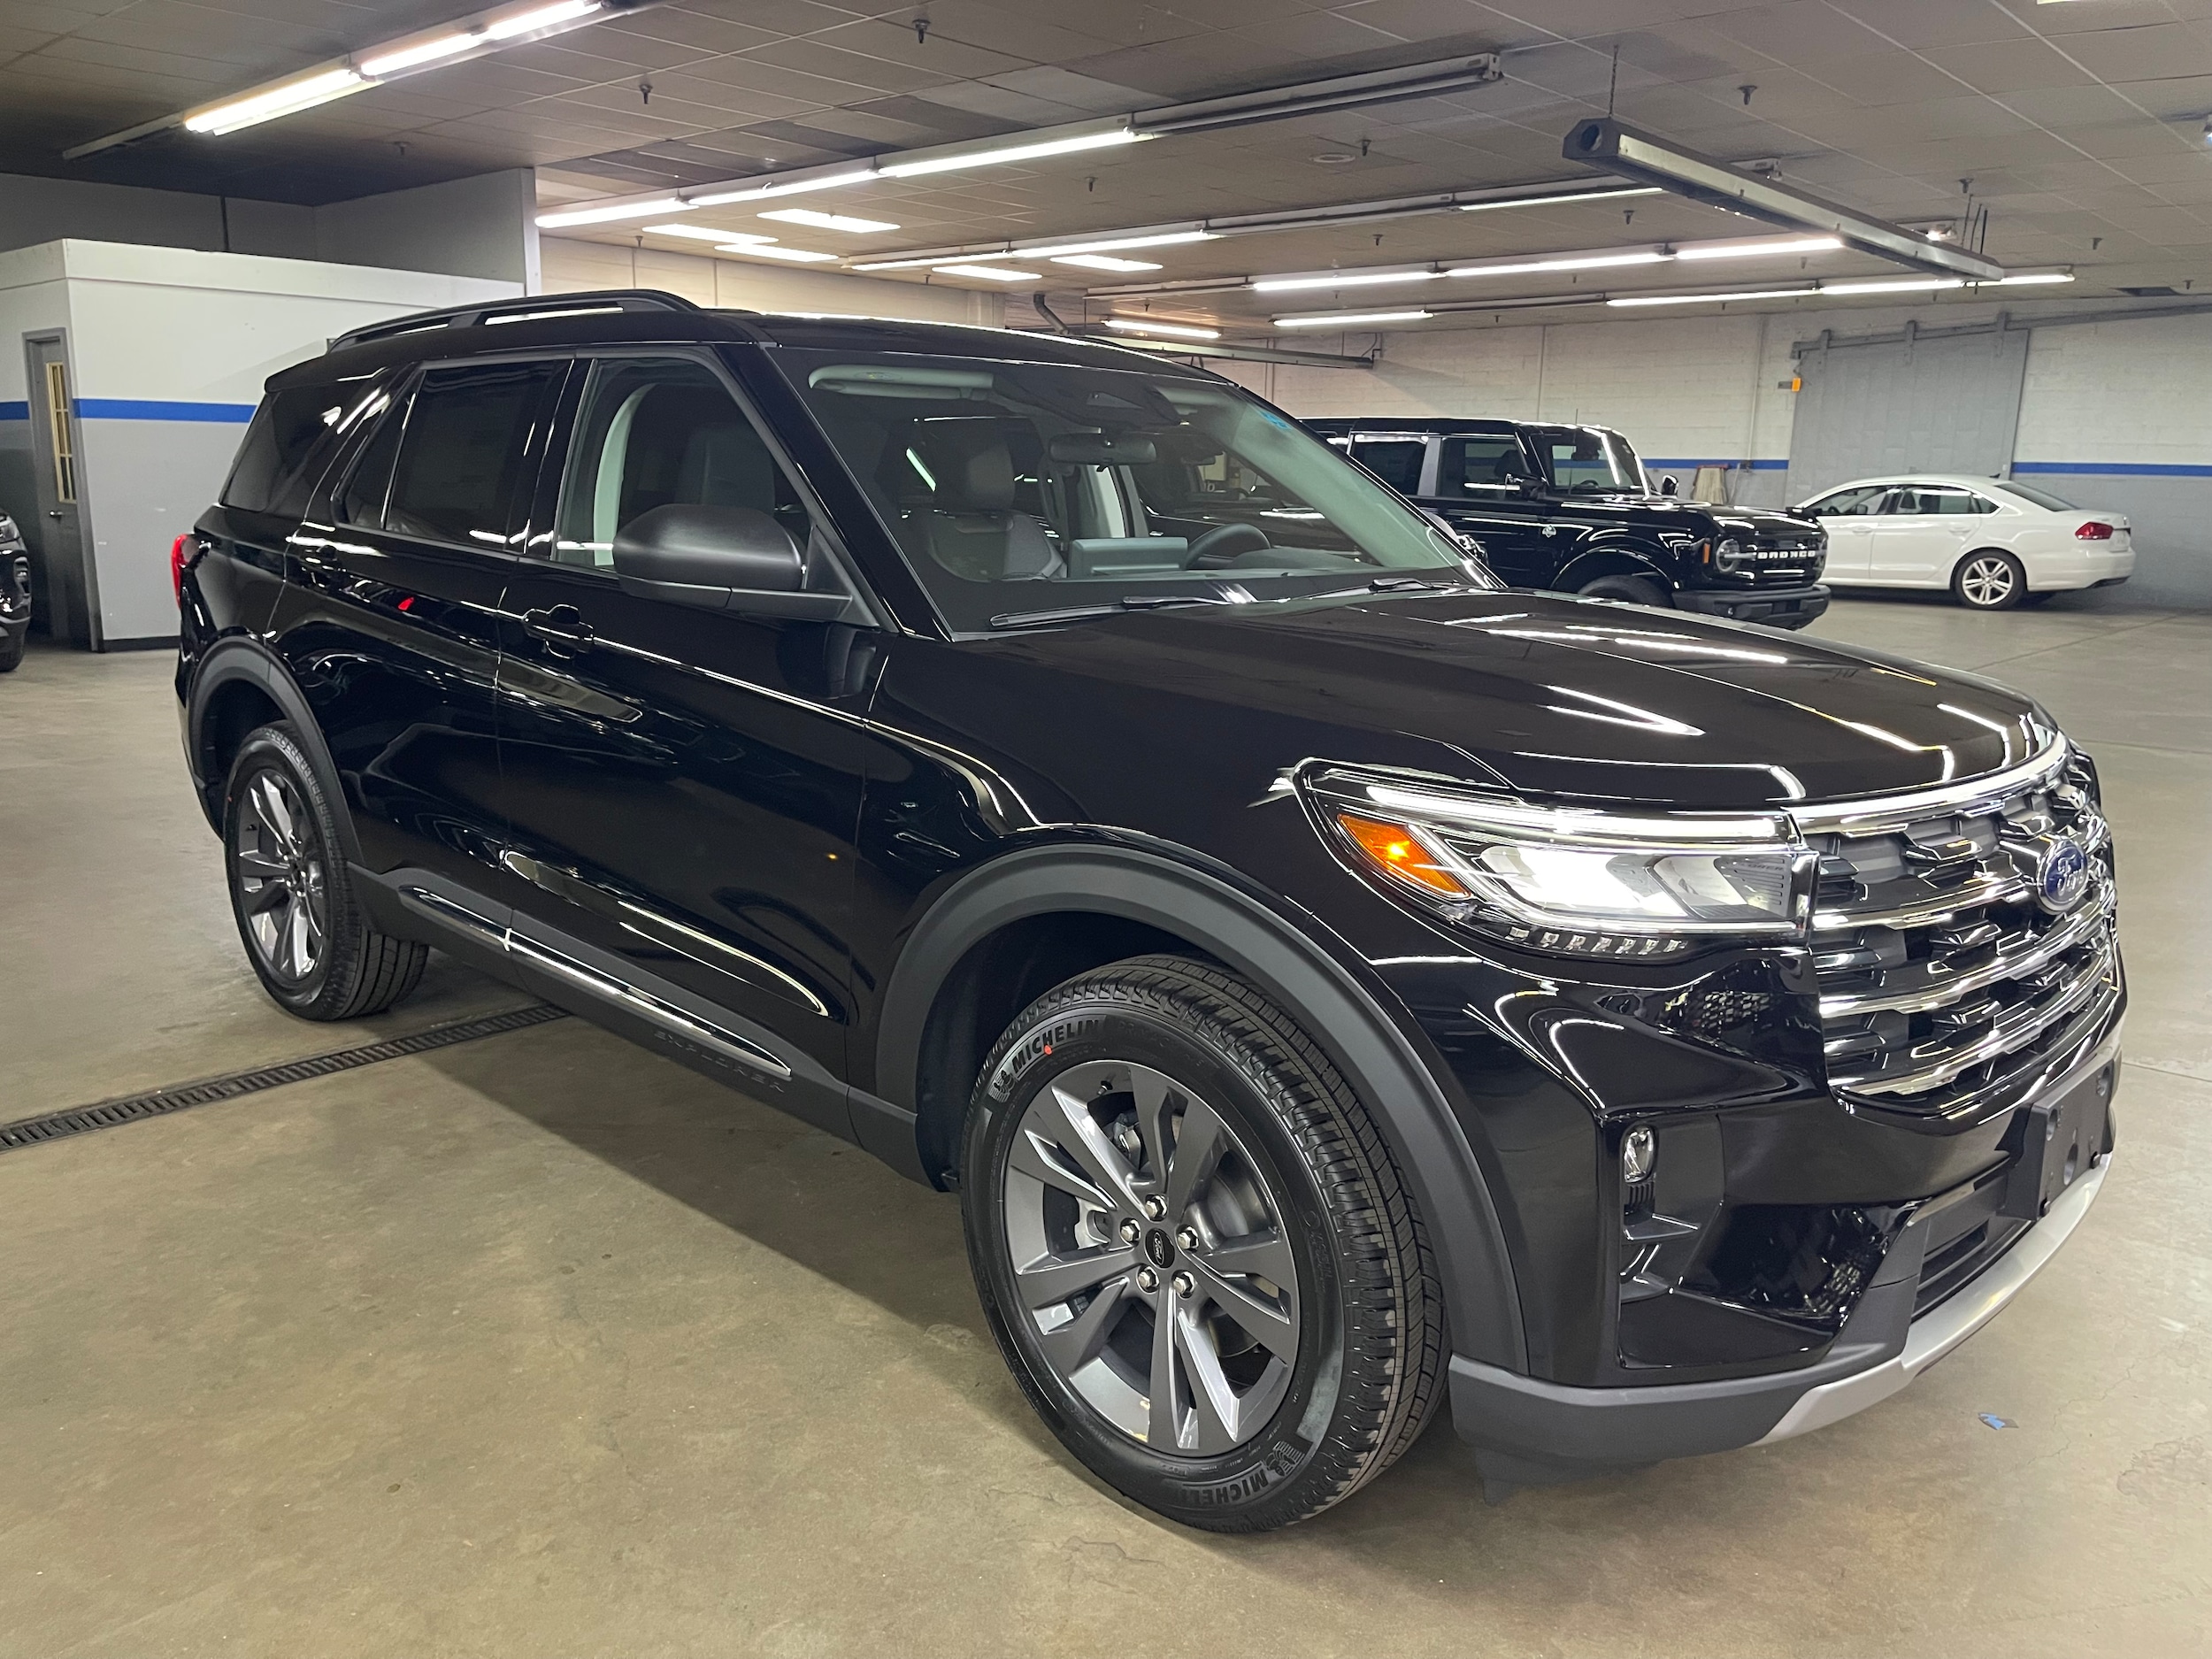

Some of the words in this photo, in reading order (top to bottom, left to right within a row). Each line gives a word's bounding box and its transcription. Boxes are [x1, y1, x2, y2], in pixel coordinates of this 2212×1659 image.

[1756, 550, 1816, 559] BRONCO
[2047, 852, 2085, 896] Ford
[653, 1030, 786, 1094] EXPLORER
[1011, 1019, 1099, 1073] MICHELIN
[1170, 1469, 1269, 1505] MICHELI
